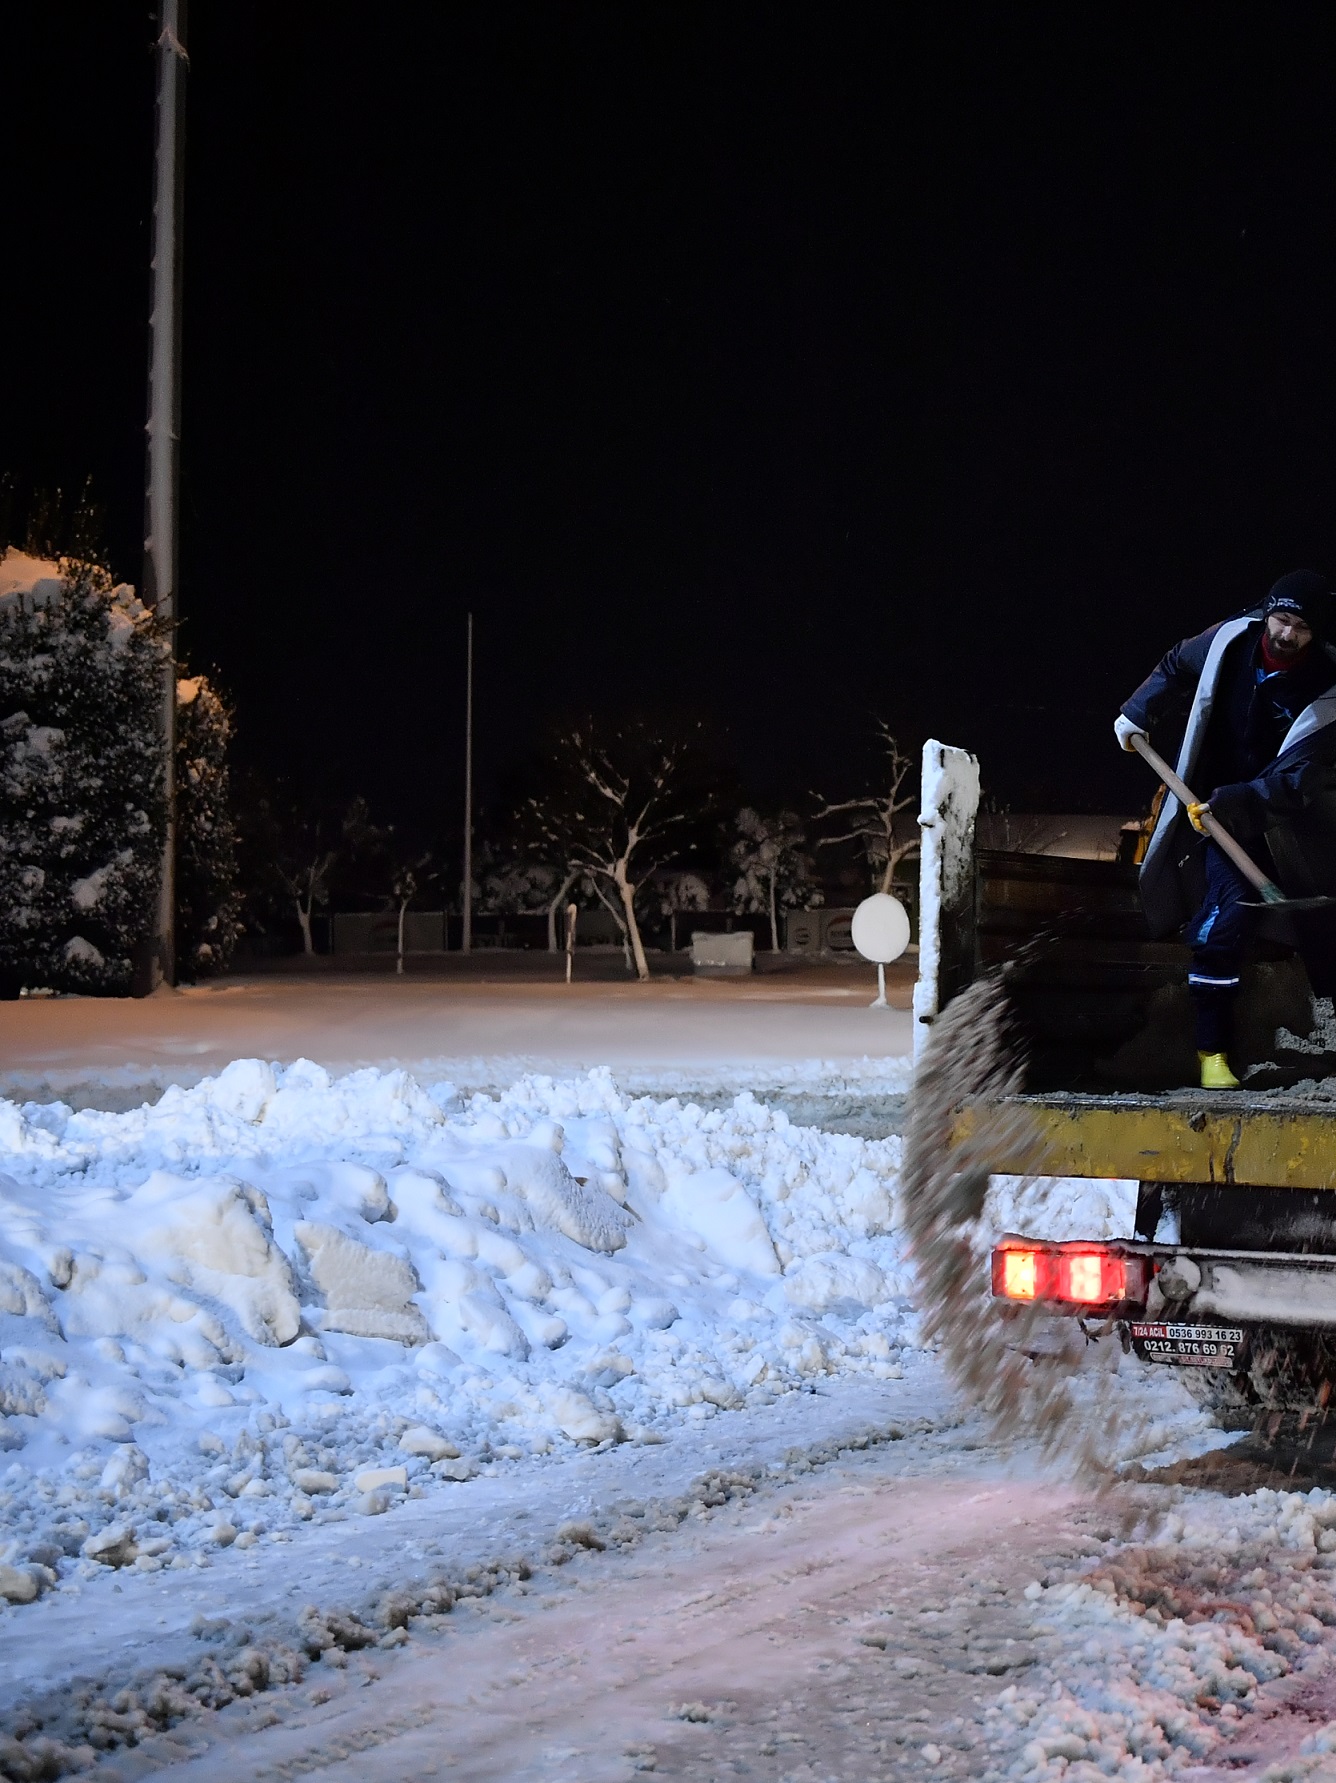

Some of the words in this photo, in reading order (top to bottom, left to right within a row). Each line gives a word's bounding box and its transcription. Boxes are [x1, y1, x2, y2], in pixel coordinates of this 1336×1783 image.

[1133, 1326, 1148, 1337] 7/24
[1169, 1328, 1193, 1339] 0536
[1195, 1330, 1213, 1340] 993
[1215, 1330, 1227, 1340] 16
[1229, 1331, 1242, 1341] 23
[1143, 1340, 1176, 1352] 0212.
[1178, 1342, 1200, 1354] 876
[1202, 1343, 1217, 1355] 69
[1220, 1344, 1235, 1357] 62
